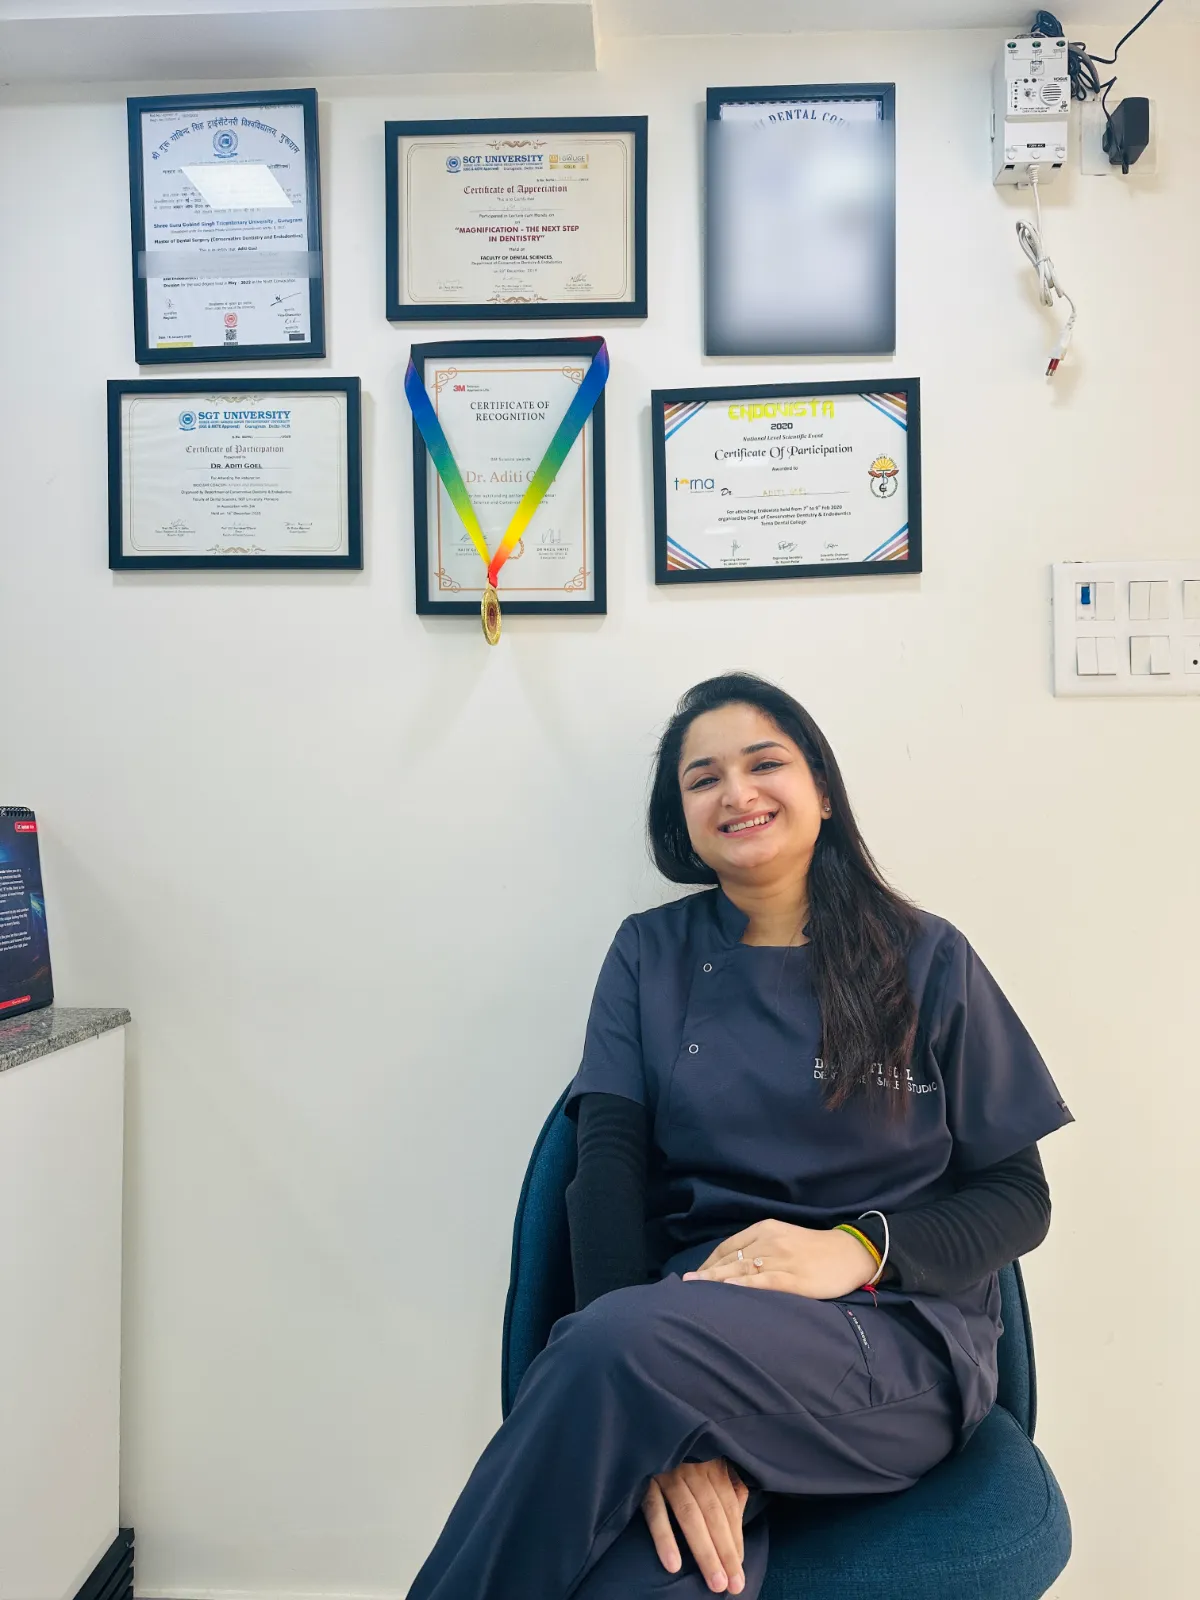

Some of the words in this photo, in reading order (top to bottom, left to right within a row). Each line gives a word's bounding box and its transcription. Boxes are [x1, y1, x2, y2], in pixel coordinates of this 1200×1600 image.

[484, 154, 544, 163] UNIVERSITY
[463, 186, 504, 194] Certificate
[506, 186, 514, 194] of
[517, 184, 568, 194] Appreciation
[470, 401, 535, 410] CERTIFICATE
[536, 400, 550, 410] OF
[198, 411, 220, 420] SGT
[224, 410, 292, 420] UNIVERSITY
[728, 398, 835, 424] ENDOVISTA
[476, 412, 546, 421] RECOGNITION
[770, 422, 794, 430] 2020
[186, 445, 224, 454] Certificate
[226, 445, 233, 453] of
[235, 444, 284, 454] Participation
[714, 446, 767, 464] Certificate
[770, 446, 786, 460] Of
[787, 444, 853, 460] Participation
[466, 470, 486, 482] Dr.
[490, 470, 523, 483] Aditi
[907, 1082, 938, 1094] STUDIO
